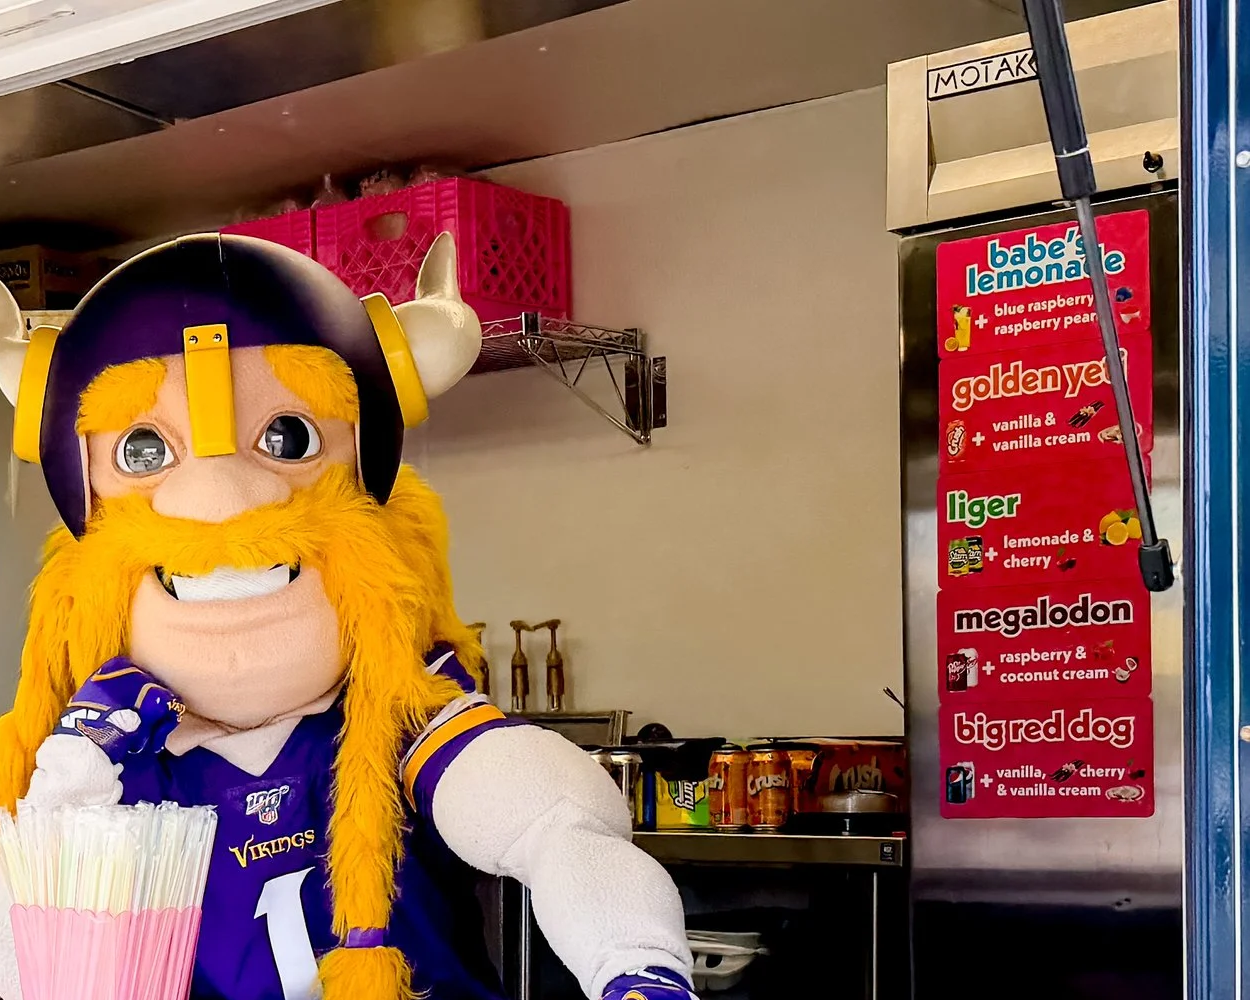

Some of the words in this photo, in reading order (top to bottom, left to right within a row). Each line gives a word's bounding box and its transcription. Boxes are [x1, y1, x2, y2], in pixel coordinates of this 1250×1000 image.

[933, 52, 1028, 94] MOTAK
[987, 227, 1086, 272] babe's
[994, 302, 1025, 317] blue
[1027, 293, 1094, 315] raspberry
[994, 313, 1061, 336] raspberry
[952, 360, 1060, 412] golden
[992, 415, 1042, 433] vanilla
[1044, 412, 1056, 427] &
[992, 434, 1042, 452] vanilla
[1044, 430, 1091, 446] cream
[946, 490, 1021, 528] liger
[1003, 530, 1079, 549] lemonade
[1082, 528, 1095, 543] &
[1003, 553, 1052, 572] cherry
[953, 593, 1134, 638] megalodon
[1000, 648, 1072, 668] raspberry
[1075, 645, 1087, 661] &
[1000, 669, 1061, 683] coconut
[1062, 667, 1109, 681] cream
[953, 712, 1008, 751] big
[1009, 709, 1065, 744] red
[1068, 708, 1135, 748] dog
[748, 770, 790, 796] Crush
[996, 764, 1047, 781] vanilla,
[1080, 764, 1125, 781] cherry
[996, 784, 1007, 797] &
[1009, 783, 1056, 797] vanilla
[1058, 785, 1102, 797] cream
